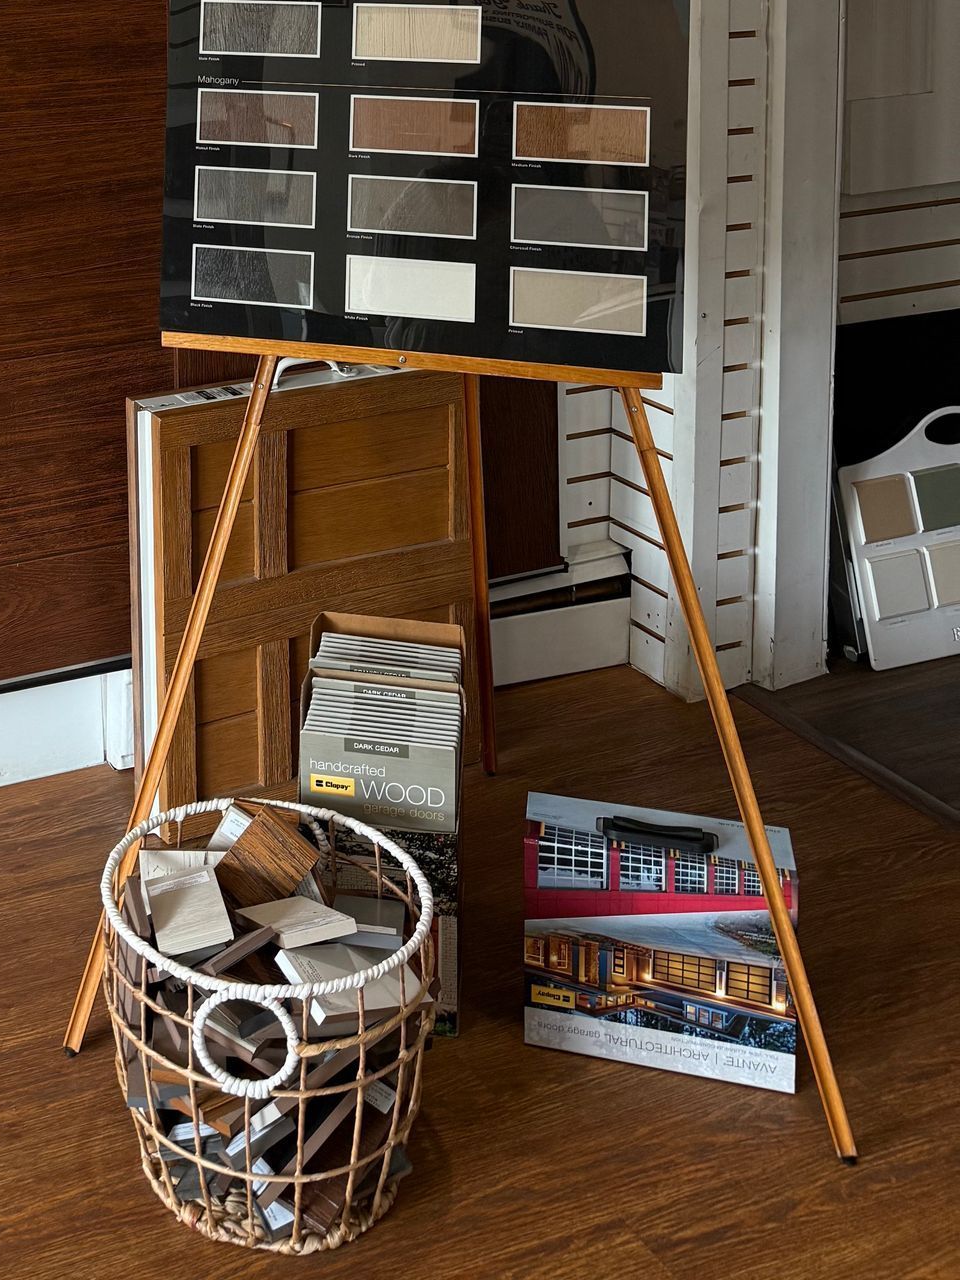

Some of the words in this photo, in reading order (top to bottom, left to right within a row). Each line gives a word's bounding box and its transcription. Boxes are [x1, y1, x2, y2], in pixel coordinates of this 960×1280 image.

[197, 75, 239, 86] Mahogany
[353, 742, 374, 751] DARK
[375, 744, 400, 754] CEDAR
[309, 757, 386, 777] handcrafted
[325, 781, 350, 791] Clopay
[360, 779, 445, 808] WOOD
[363, 802, 405, 817] garage
[409, 805, 445, 821] doors
[537, 990, 561, 1001] Clopay
[537, 1020, 565, 1034] doors
[567, 1026, 601, 1039] garage
[604, 1033, 710, 1061] ARCHITECTURAL
[724, 1055, 778, 1075] AVANTE
